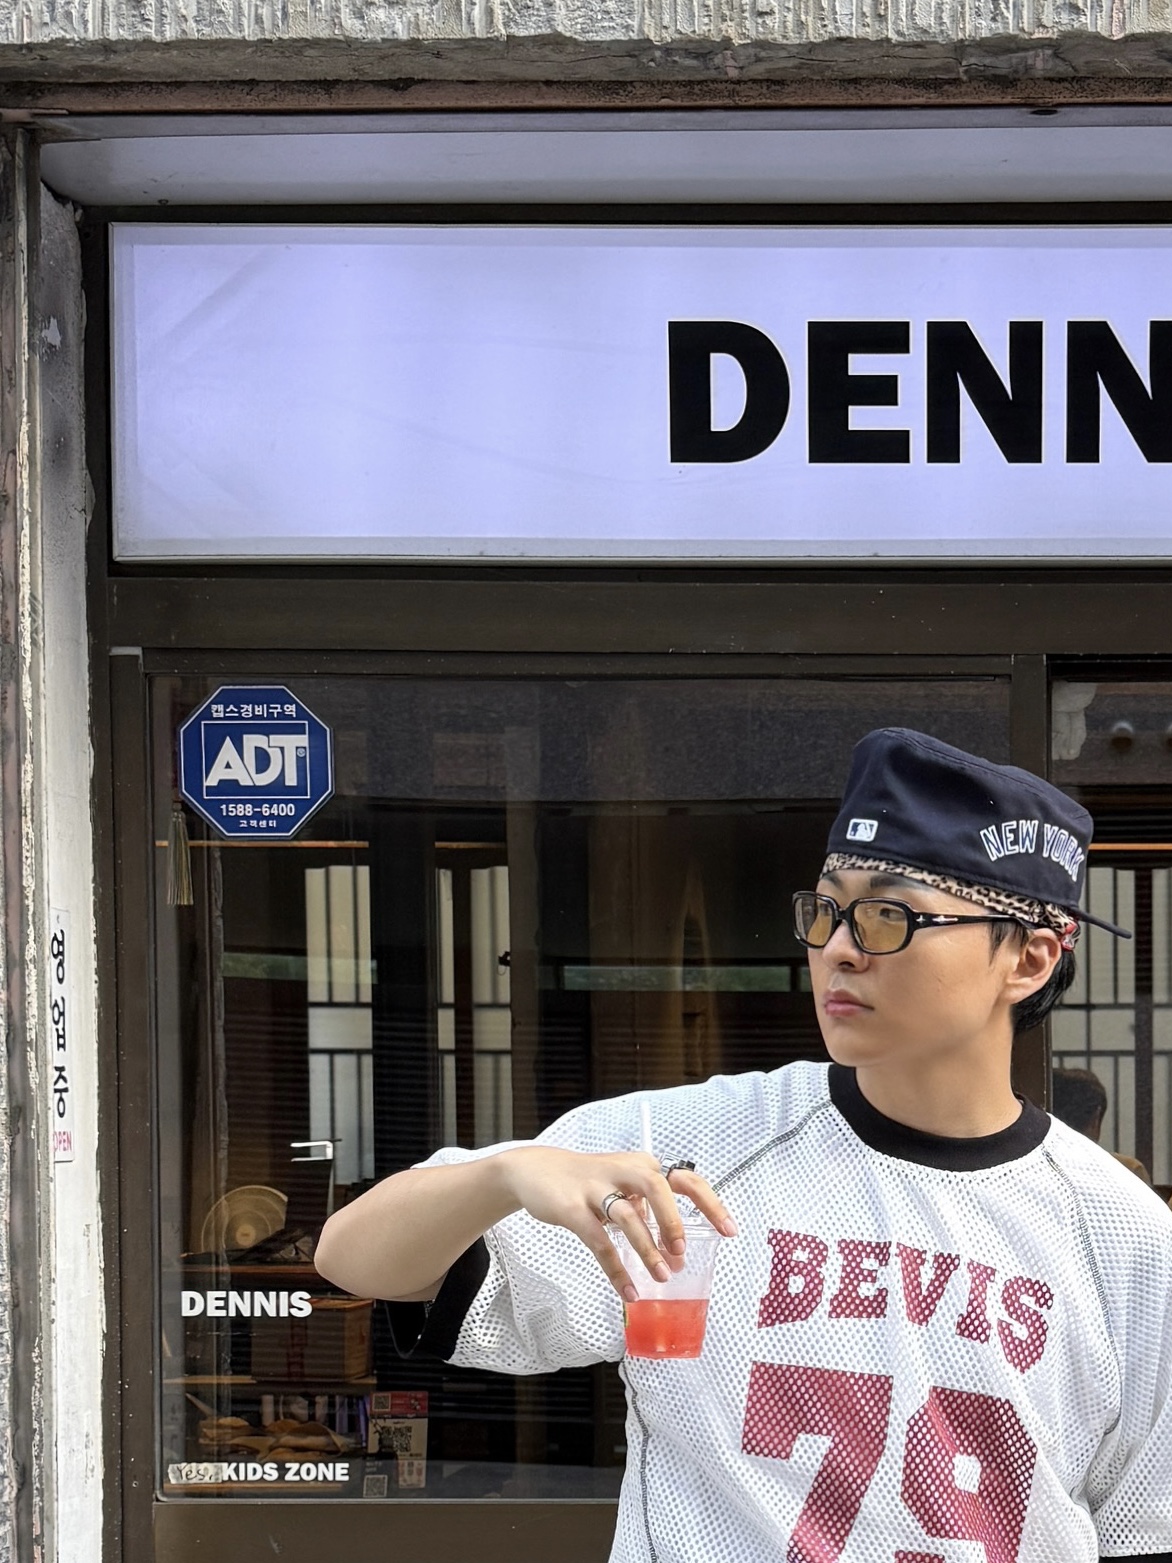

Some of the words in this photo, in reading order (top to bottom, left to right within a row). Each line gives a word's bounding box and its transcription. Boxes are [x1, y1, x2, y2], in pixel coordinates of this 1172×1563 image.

[211, 704, 297, 718] 캡스경비구역
[205, 734, 308, 786] ADT
[220, 803, 295, 817] 1588-6400
[239, 819, 277, 828] 고객센터
[980, 819, 1039, 862] NEW
[1042, 823, 1085, 882] YORK
[51, 928, 70, 1119] 영업중
[181, 1290, 313, 1318] DENNIS
[757, 1228, 1055, 1374] BEVIS
[221, 1462, 279, 1482] KIDS
[284, 1462, 350, 1482] ZONE
